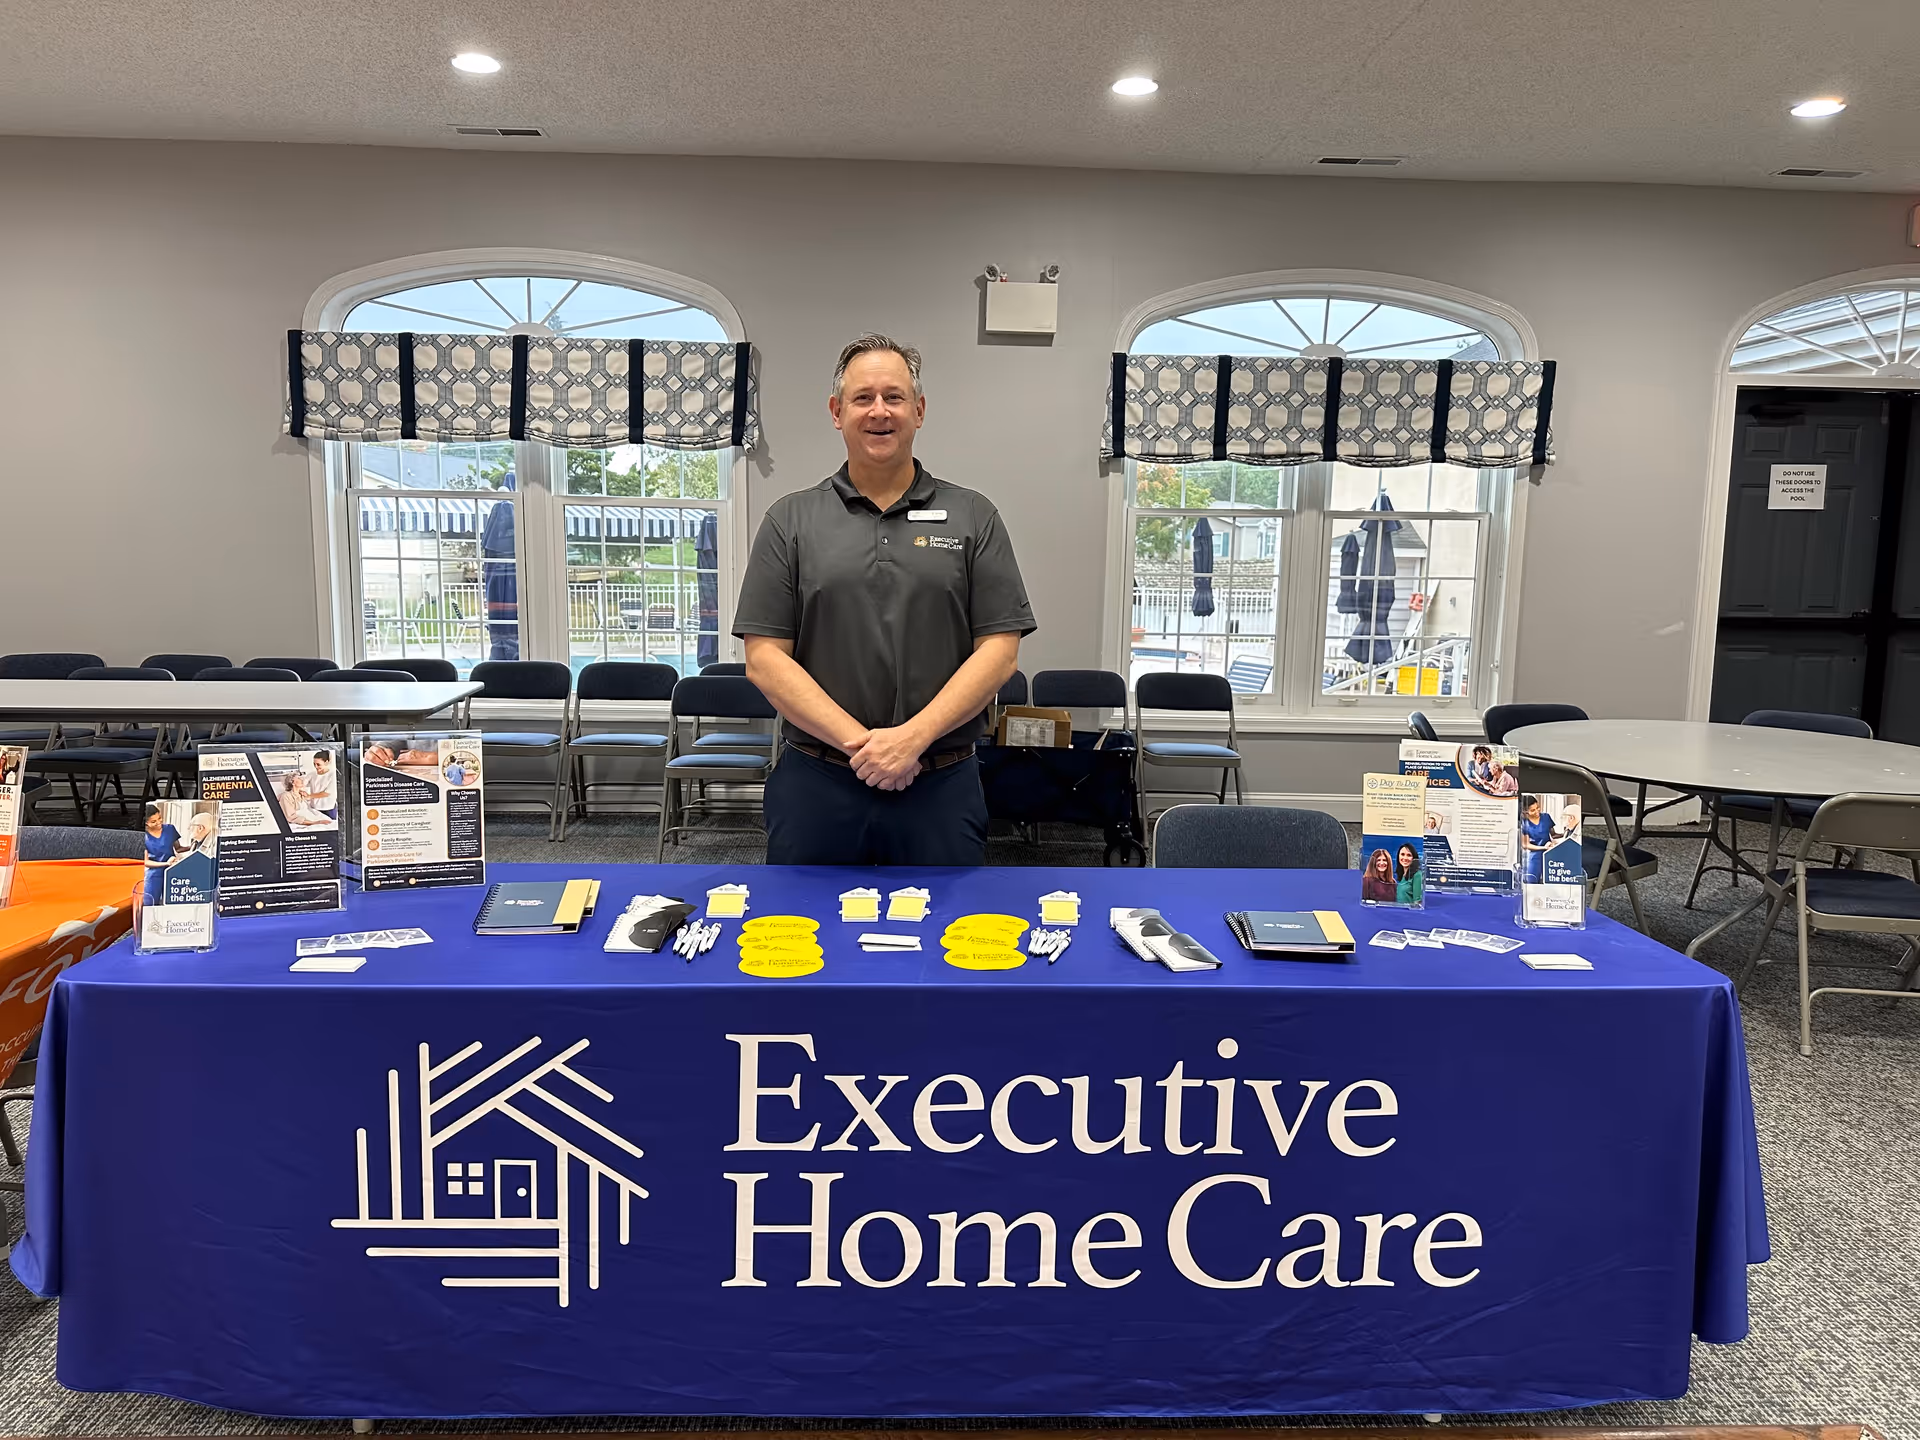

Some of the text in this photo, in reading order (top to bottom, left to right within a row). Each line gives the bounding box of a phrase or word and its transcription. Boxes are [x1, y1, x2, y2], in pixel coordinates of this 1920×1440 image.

[929, 536, 959, 544] Executive
[202, 781, 254, 790] DEMENTIA
[1380, 779, 1395, 787] Day
[1405, 780, 1420, 788] Day
[202, 791, 230, 799] CARE
[181, 886, 197, 894] give
[724, 1034, 1398, 1156] Executive
[722, 1173, 1483, 1288] Home Care
